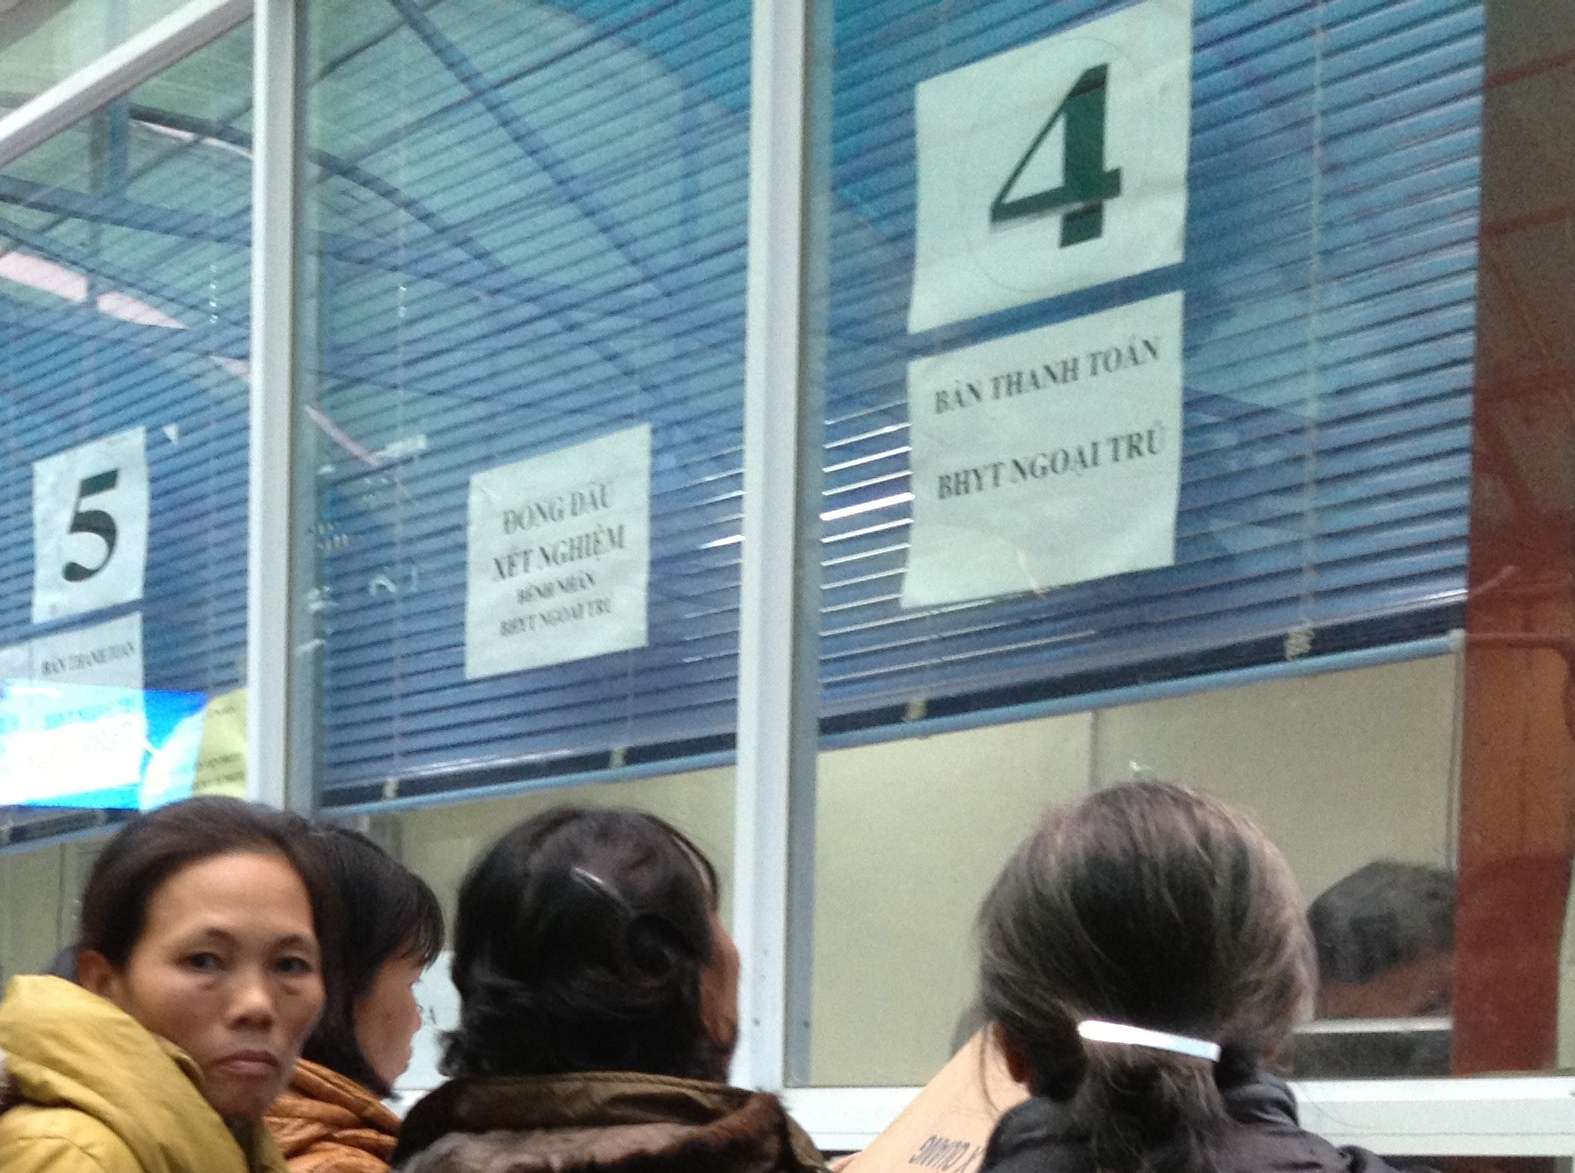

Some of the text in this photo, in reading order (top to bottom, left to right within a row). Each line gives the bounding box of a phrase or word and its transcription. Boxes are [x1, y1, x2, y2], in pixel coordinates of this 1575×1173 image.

[989, 62, 1123, 248] 4
[991, 357, 1080, 401] THANH
[1086, 335, 1161, 377] TOÁN
[938, 461, 1005, 501] BHYT
[1008, 441, 1101, 484] NGOẠI
[61, 468, 120, 583] 5
